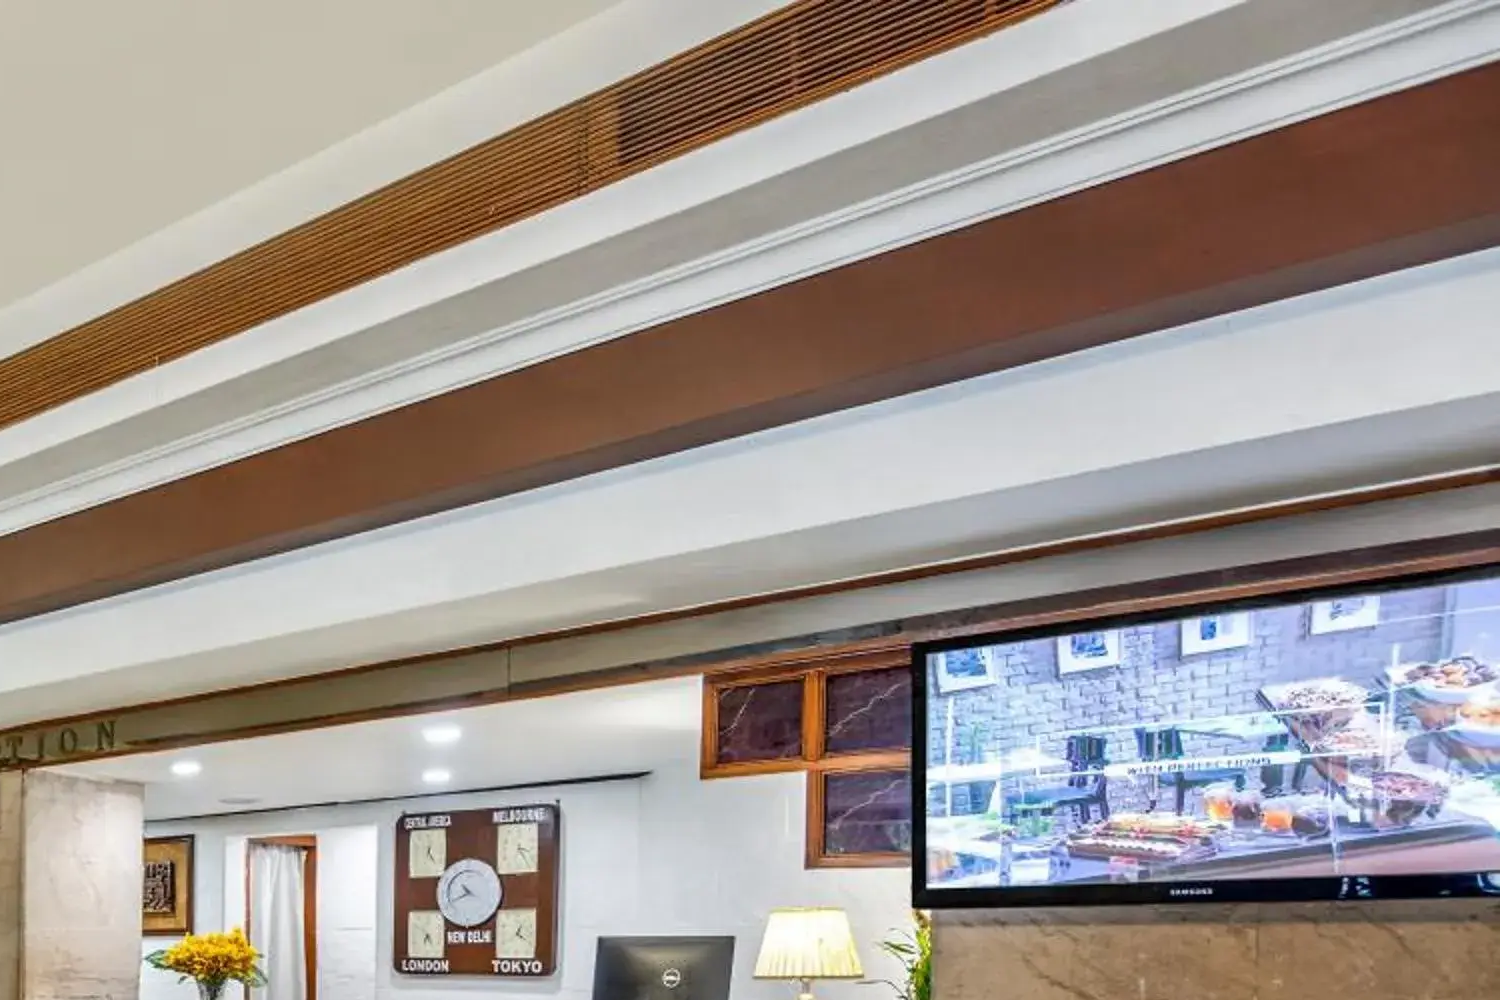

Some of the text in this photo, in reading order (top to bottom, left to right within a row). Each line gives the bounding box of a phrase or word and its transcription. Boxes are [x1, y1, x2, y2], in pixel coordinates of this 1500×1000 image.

[492, 808, 547, 824] MELBOURNE
[447, 931, 492, 944] NEW DELHI
[401, 959, 449, 972] LONDON
[491, 960, 542, 973] TOKYO
